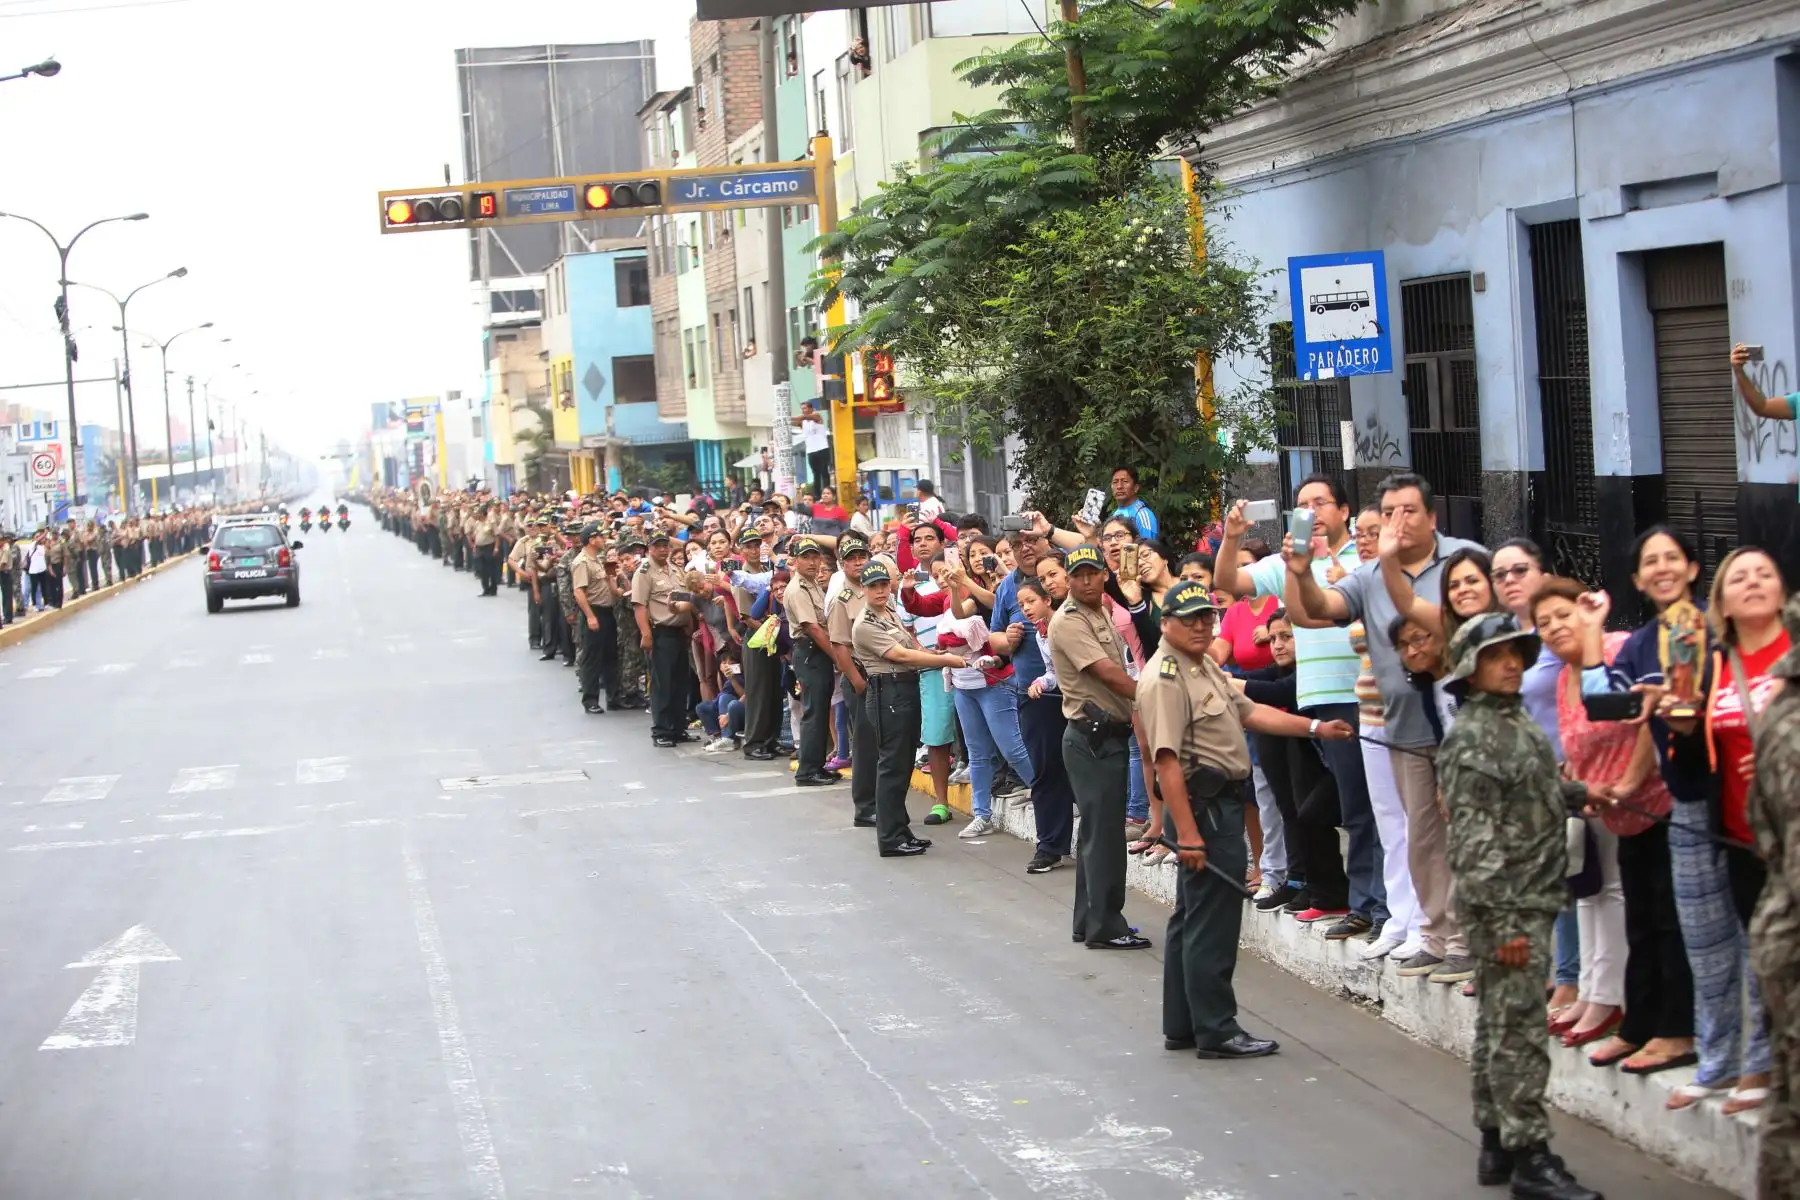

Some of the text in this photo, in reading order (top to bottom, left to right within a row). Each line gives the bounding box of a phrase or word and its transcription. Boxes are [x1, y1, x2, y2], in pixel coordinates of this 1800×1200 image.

[685, 179, 799, 199] Jr. Cárcamo
[511, 190, 569, 203] MUNICIPALIDAD
[541, 202, 560, 211] LIMA
[1309, 347, 1379, 370] PARADERO
[37, 460, 52, 470] 60
[842, 539, 863, 551] POLICIA
[1067, 548, 1097, 565] POLICIA
[234, 569, 267, 579] POLICIA
[863, 565, 887, 577] POLICIA
